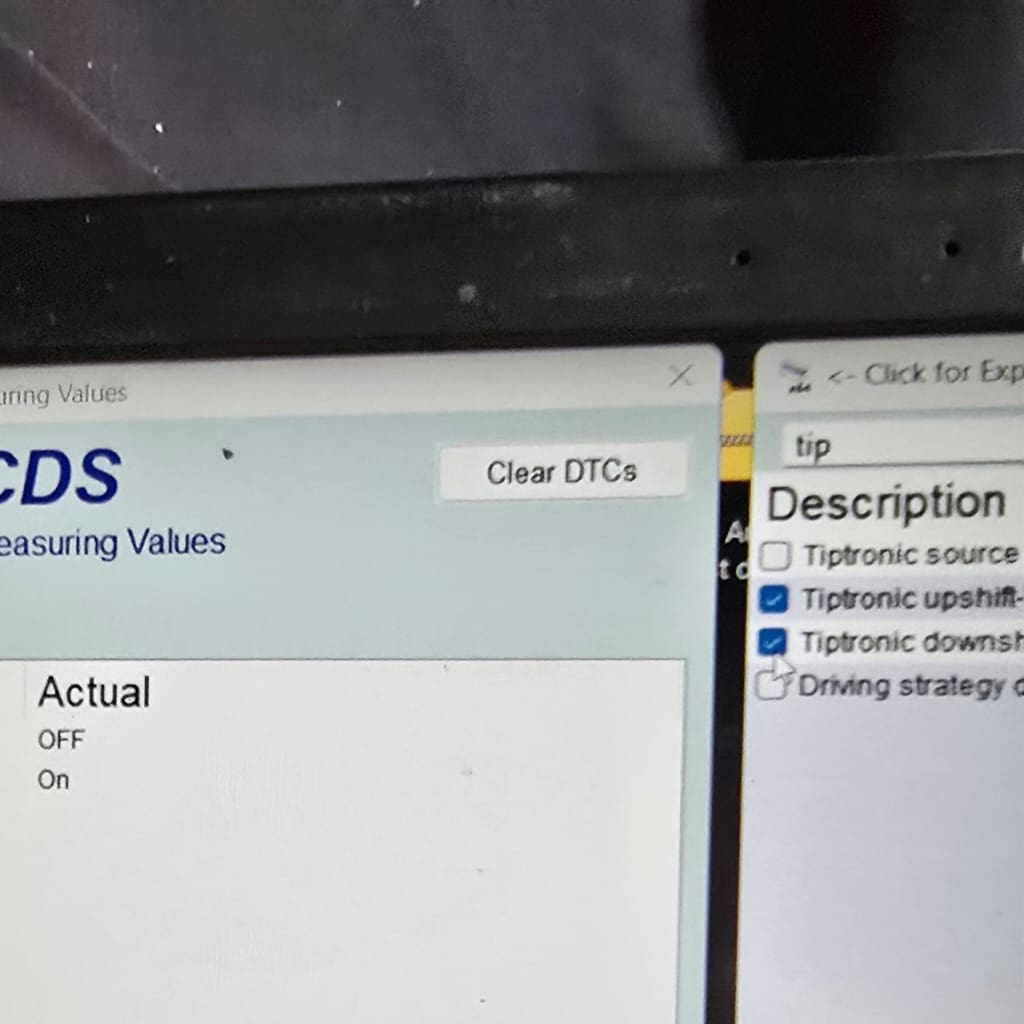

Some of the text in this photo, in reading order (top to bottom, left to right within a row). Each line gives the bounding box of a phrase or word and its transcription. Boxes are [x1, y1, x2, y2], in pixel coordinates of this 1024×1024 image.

[865, 361, 926, 386] Click
[936, 360, 971, 383] for
[58, 383, 128, 403] Values
[796, 431, 831, 463] tip
[487, 458, 638, 486] Clear DTCs
[768, 482, 1006, 529] Description
[126, 528, 227, 556] Values
[804, 543, 1020, 570] Tiptronic source
[802, 587, 916, 614] Tiptronic
[802, 630, 914, 657] Tiptronic
[38, 673, 151, 710] Actual
[798, 674, 890, 704] Driving
[899, 674, 1006, 703] strategy
[38, 729, 85, 751] OFF
[38, 769, 71, 791] On
